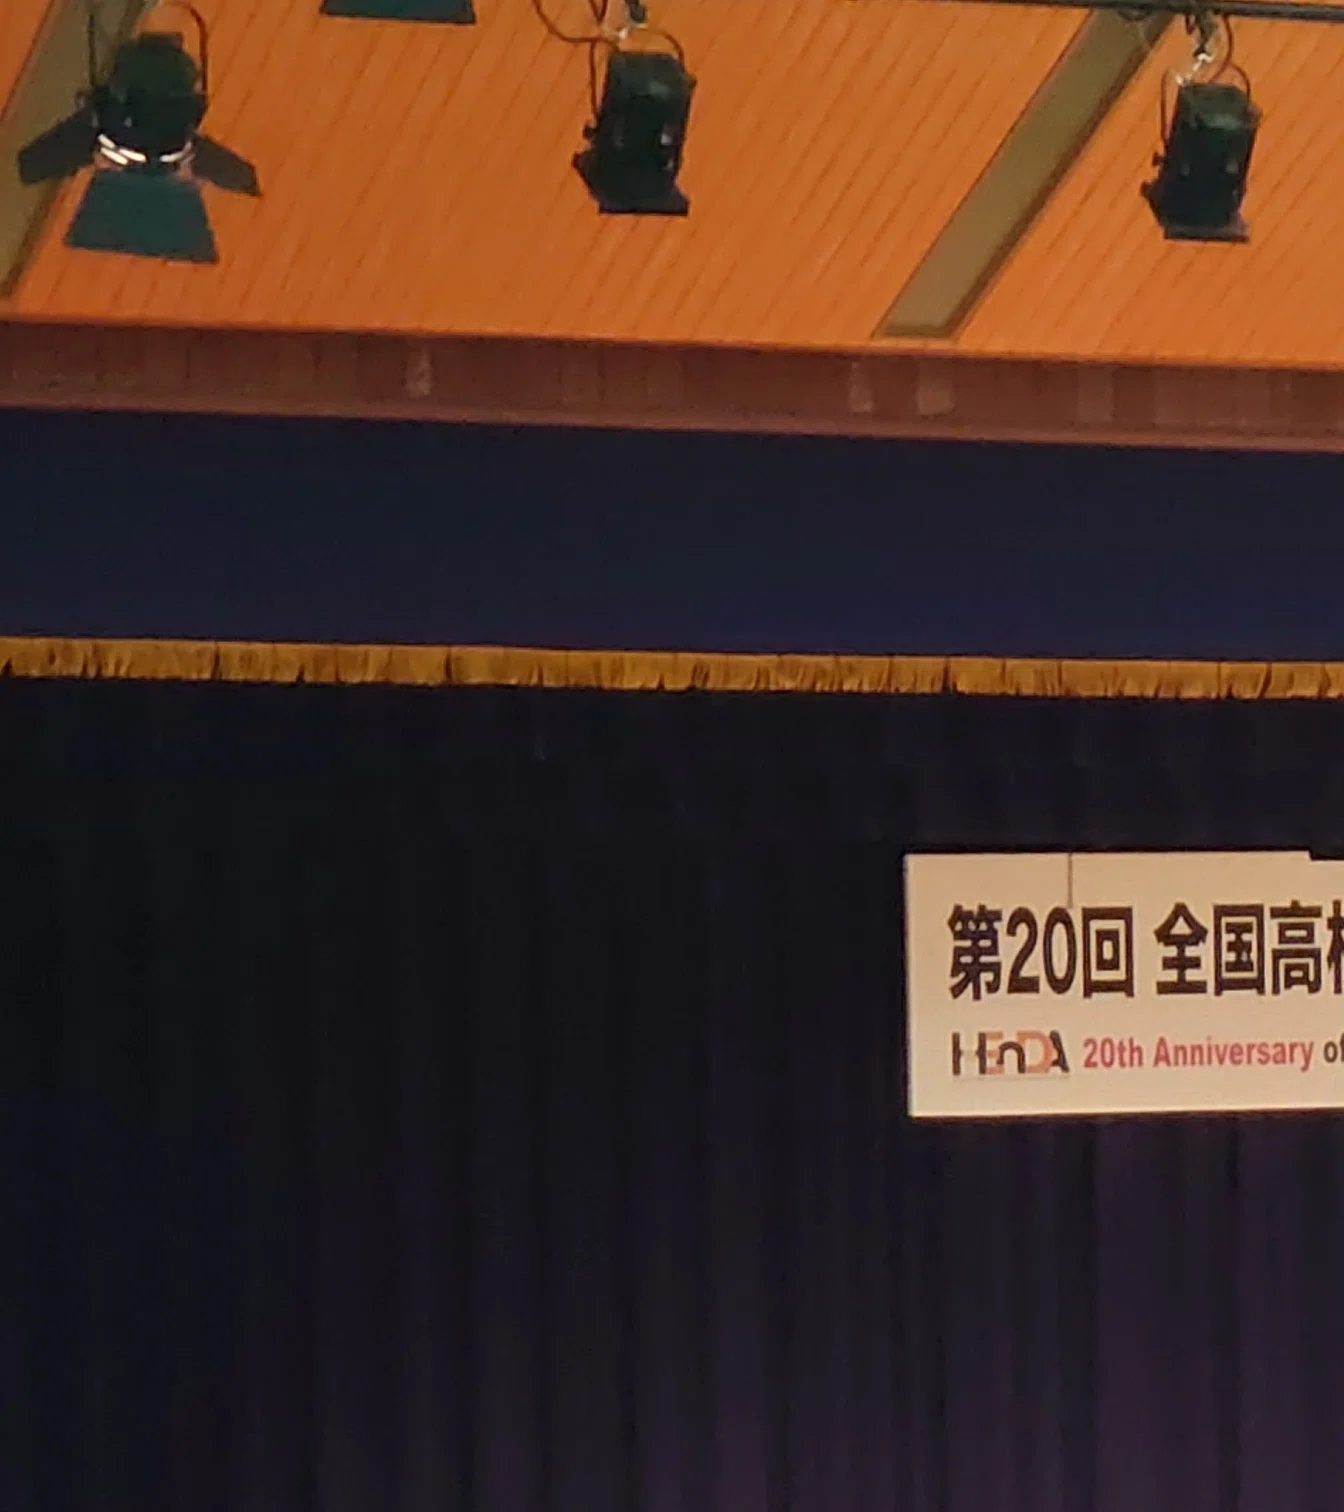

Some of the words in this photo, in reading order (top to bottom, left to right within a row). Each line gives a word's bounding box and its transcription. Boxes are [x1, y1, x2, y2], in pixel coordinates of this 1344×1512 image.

[946, 902, 1135, 1001] 第20回
[1082, 1035, 1143, 1069] 20th
[1152, 1034, 1315, 1072] Anniversary
